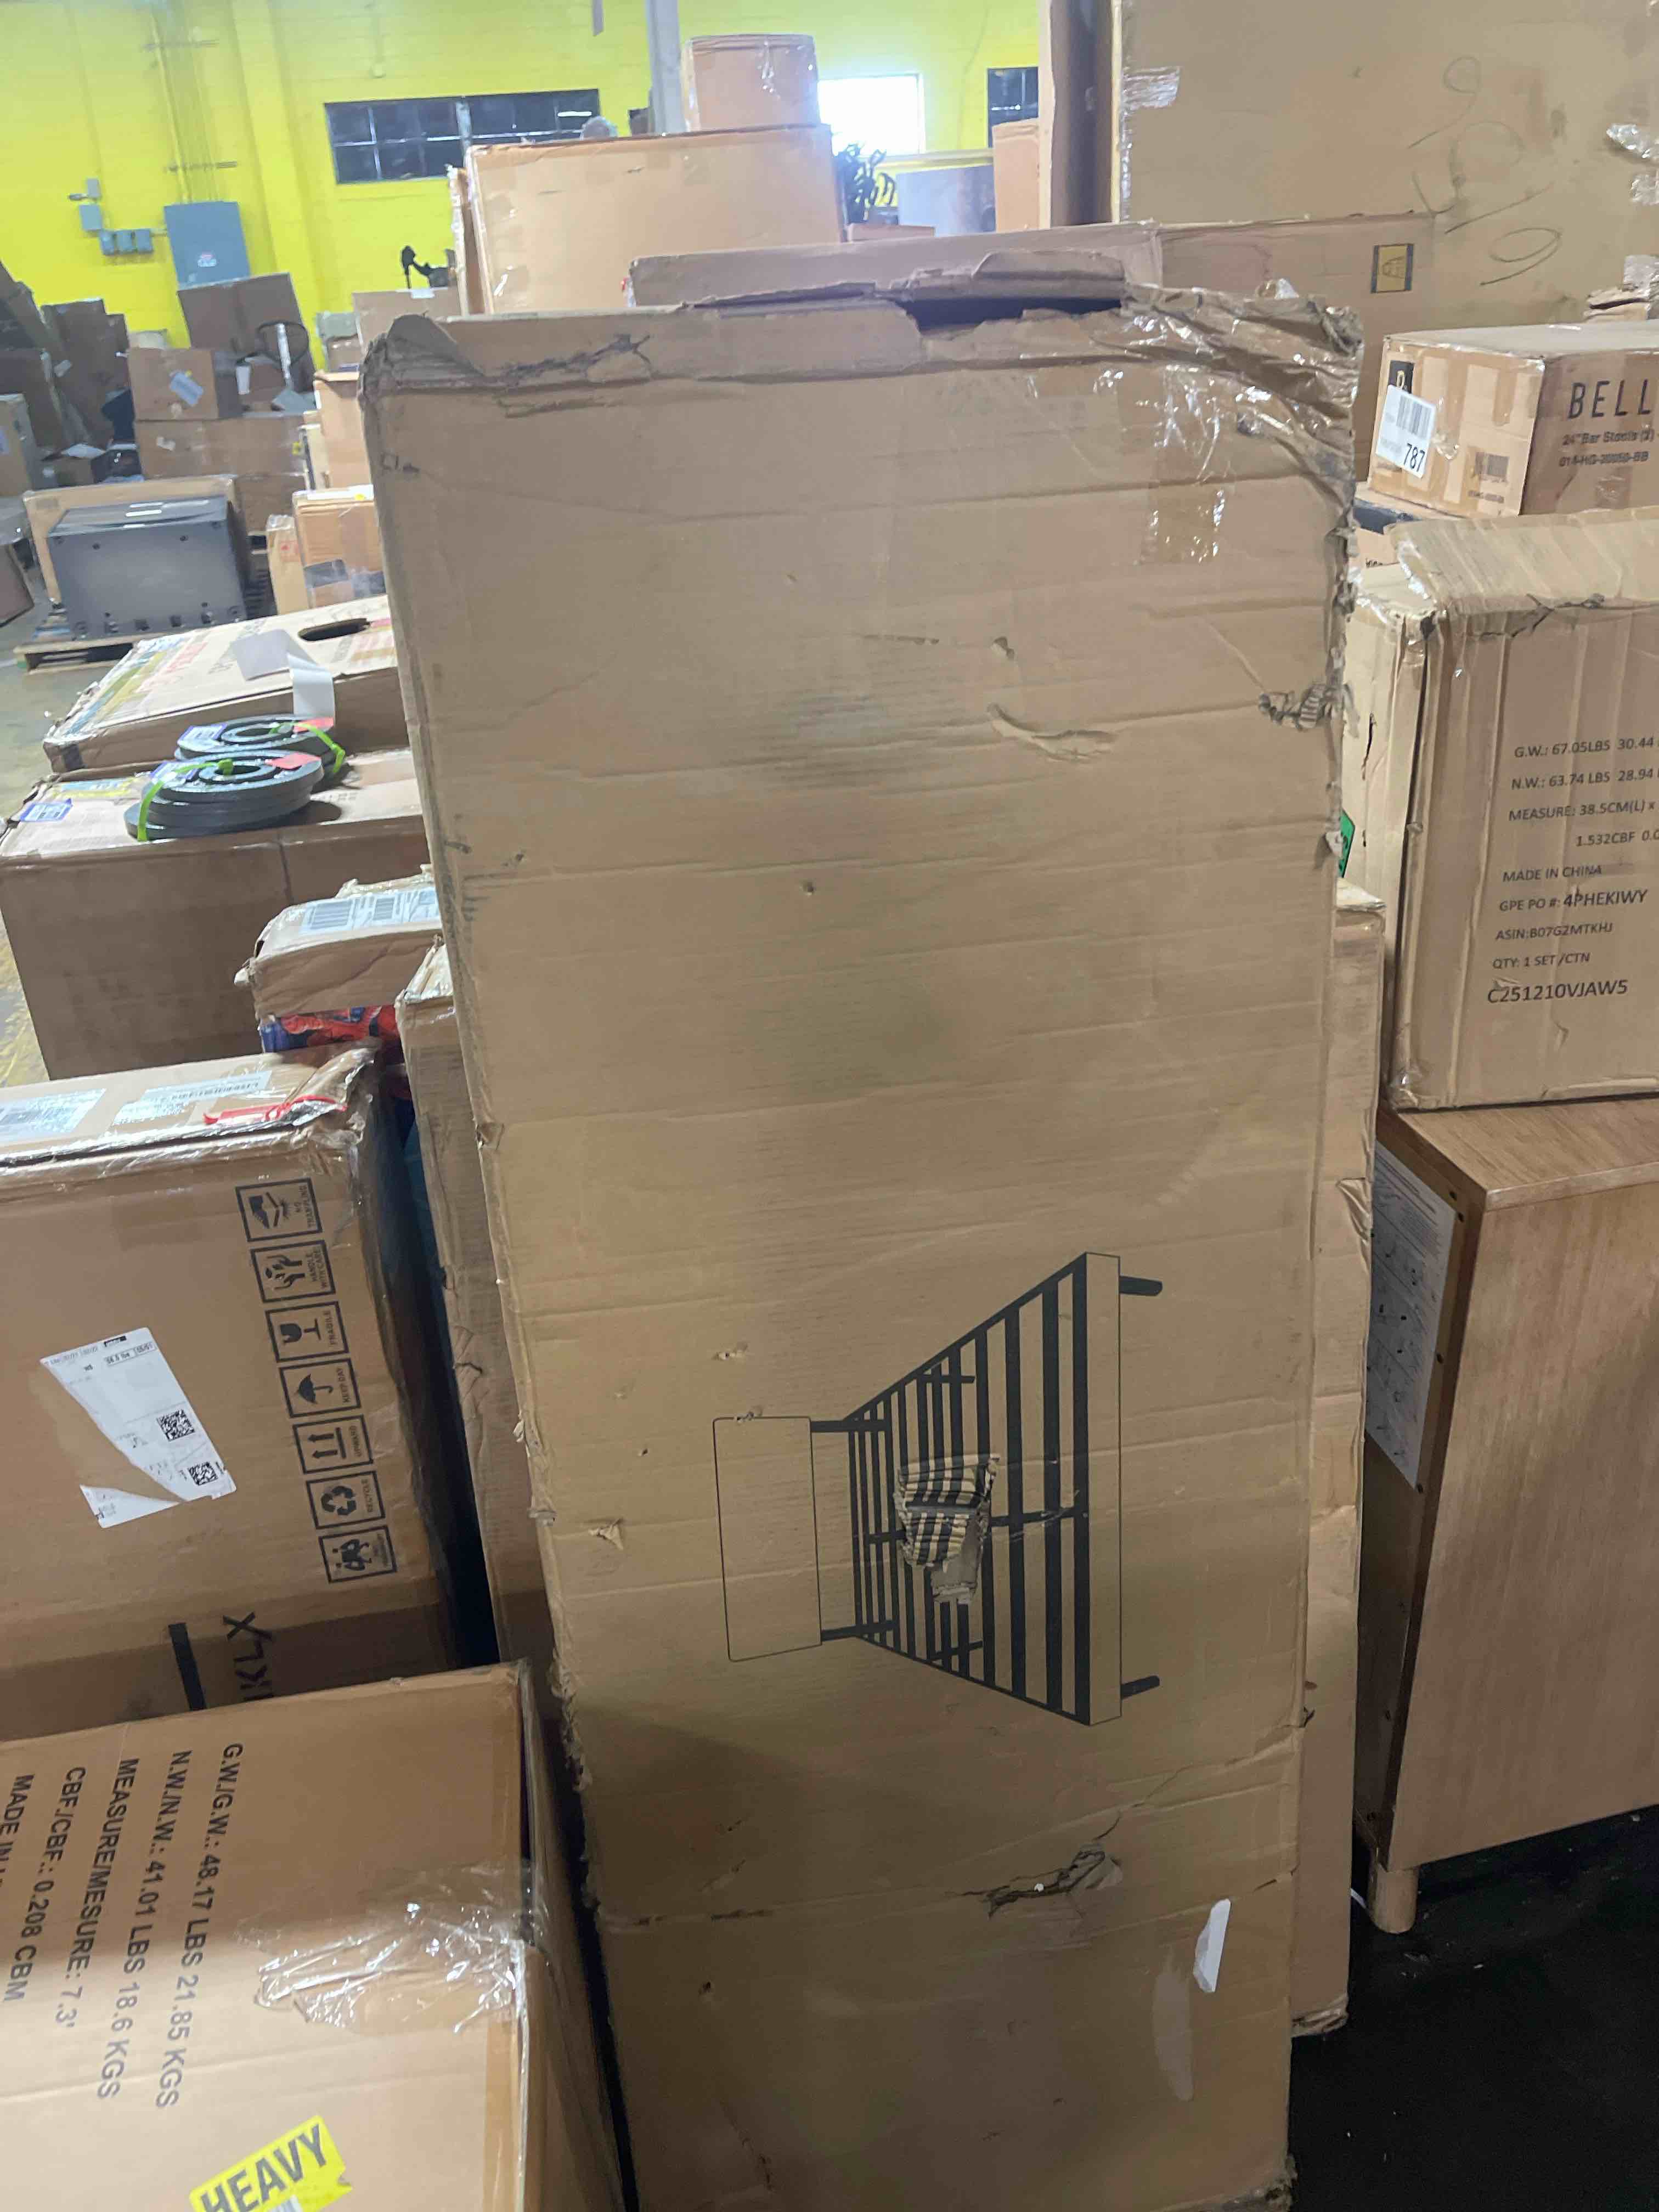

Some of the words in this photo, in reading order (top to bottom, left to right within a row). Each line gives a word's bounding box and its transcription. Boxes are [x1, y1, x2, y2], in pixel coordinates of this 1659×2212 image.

[1568, 379, 1651, 419] BELL
[1403, 443, 1425, 472] 787
[1617, 737, 1654, 750] 30.44
[1549, 774, 1584, 787] 63.74
[1588, 771, 1610, 783] LBS
[1617, 768, 1654, 782] 28.94
[1509, 805, 1576, 821] MEASURE:
[1579, 799, 1646, 816] 38.5CM(L)
[1576, 831, 1635, 847] 1.532CBF
[1503, 868, 1542, 883] MADE
[1545, 867, 1559, 879] IN
[1562, 865, 1602, 878] CHINA
[1499, 900, 1524, 912] GPE
[1528, 898, 1546, 910] PO
[1492, 958, 1519, 969] QTY:
[1524, 956, 1530, 967] 1
[1534, 955, 1556, 966] SET
[1558, 952, 1591, 966] /CTN
[305, 1252, 317, 1282] HANDLE
[324, 1310, 338, 1347] FRAGILE
[349, 1425, 362, 1457] UPWARD
[361, 1479, 374, 1513] RECYCLE
[0, 1773, 35, 1835] MADE
[38, 1767, 87, 1874] CBF./CBF.:
[149, 1750, 192, 1855] N.W./N.W.:
[204, 1742, 244, 1849] G.W./G.W.:
[65, 1758, 140, 1980] MEASURE/MESURE:
[135, 1860, 166, 1916] 41.01
[192, 1854, 221, 1910] 48.17
[21, 1878, 54, 1939] 0.208
[123, 1924, 153, 1974] LBS
[181, 1918, 209, 1967] LBS
[3, 1944, 37, 2002] CBM
[111, 1982, 140, 2033] 18.6
[167, 1974, 199, 2041] 21.85
[97, 2039, 129, 2100] KGS
[156, 2048, 187, 2108] KGS
[200, 2124, 327, 2212] HEAVY
